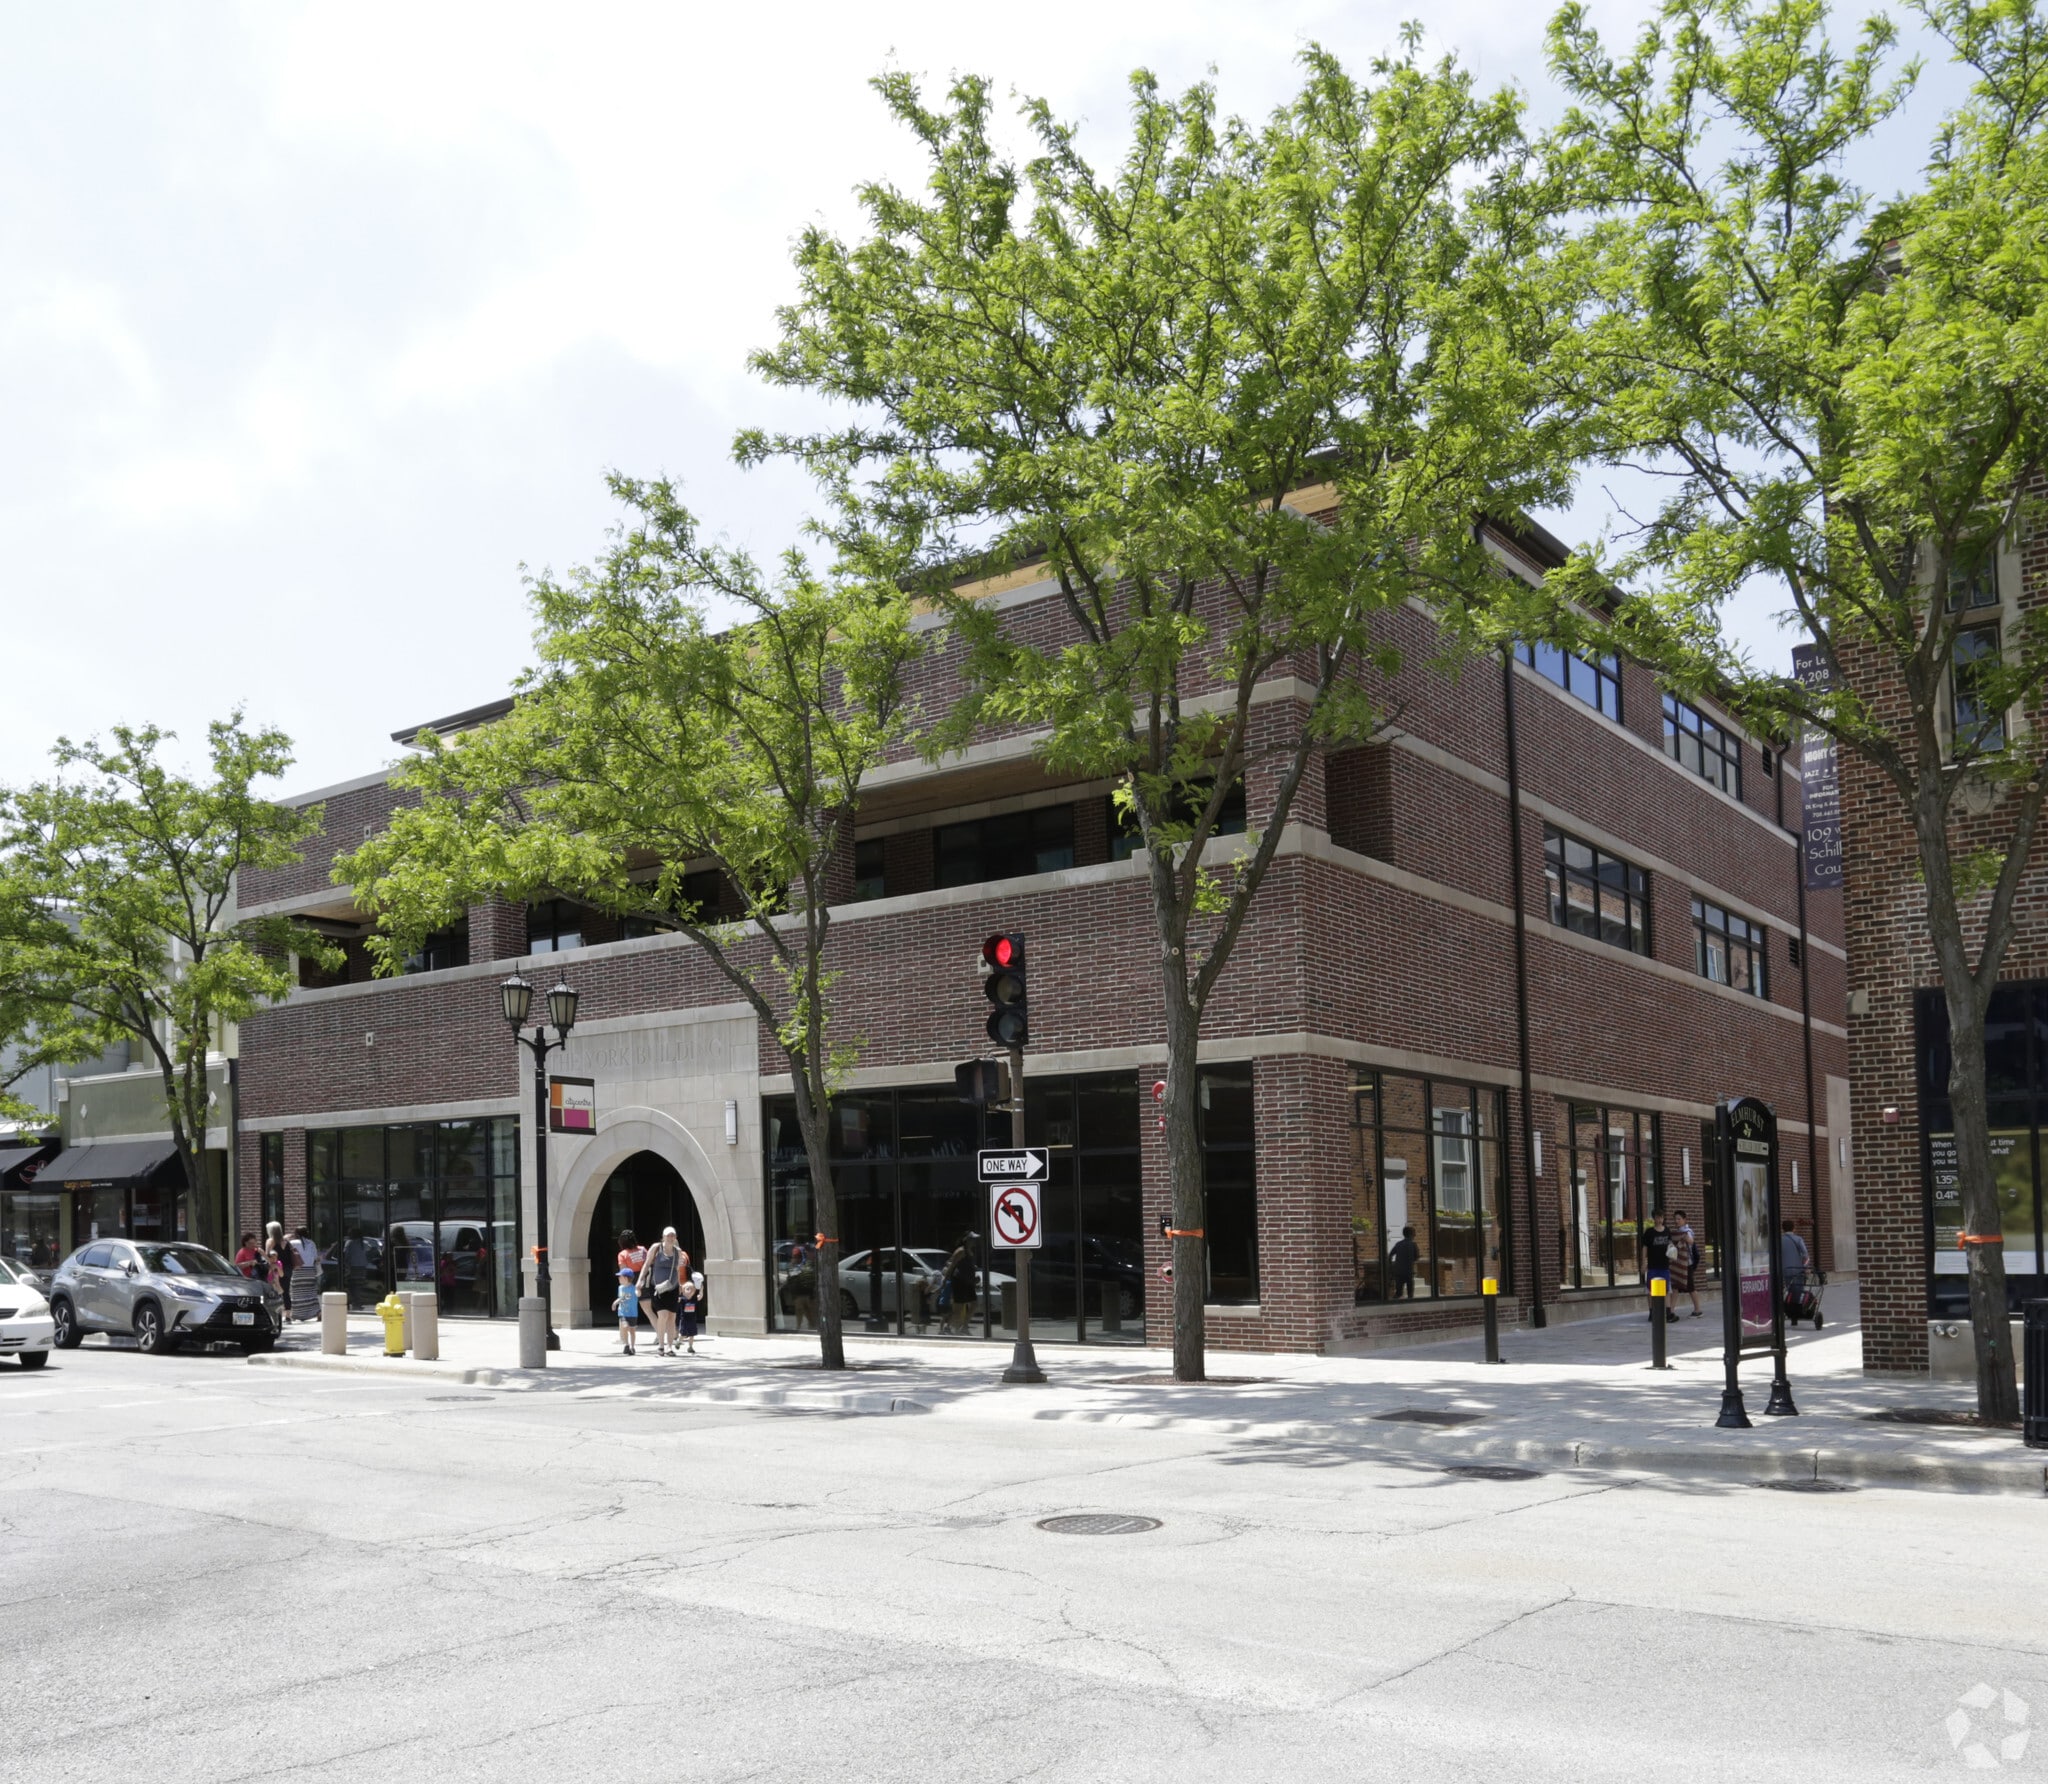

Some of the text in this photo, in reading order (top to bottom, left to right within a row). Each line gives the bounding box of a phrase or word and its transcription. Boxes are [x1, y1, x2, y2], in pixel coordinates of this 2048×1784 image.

[1796, 659, 1812, 670] For
[1807, 827, 1832, 843] 109
[584, 1048, 631, 1068] YORK
[637, 1037, 721, 1066] BUILDING
[1730, 1106, 1764, 1132] ELMHURST
[1931, 1141, 1952, 1149] When
[1998, 1138, 2016, 1146] time
[1991, 1147, 2010, 1155] what
[986, 1159, 1027, 1172] ONE WAY
[1932, 1159, 1946, 1167] you
